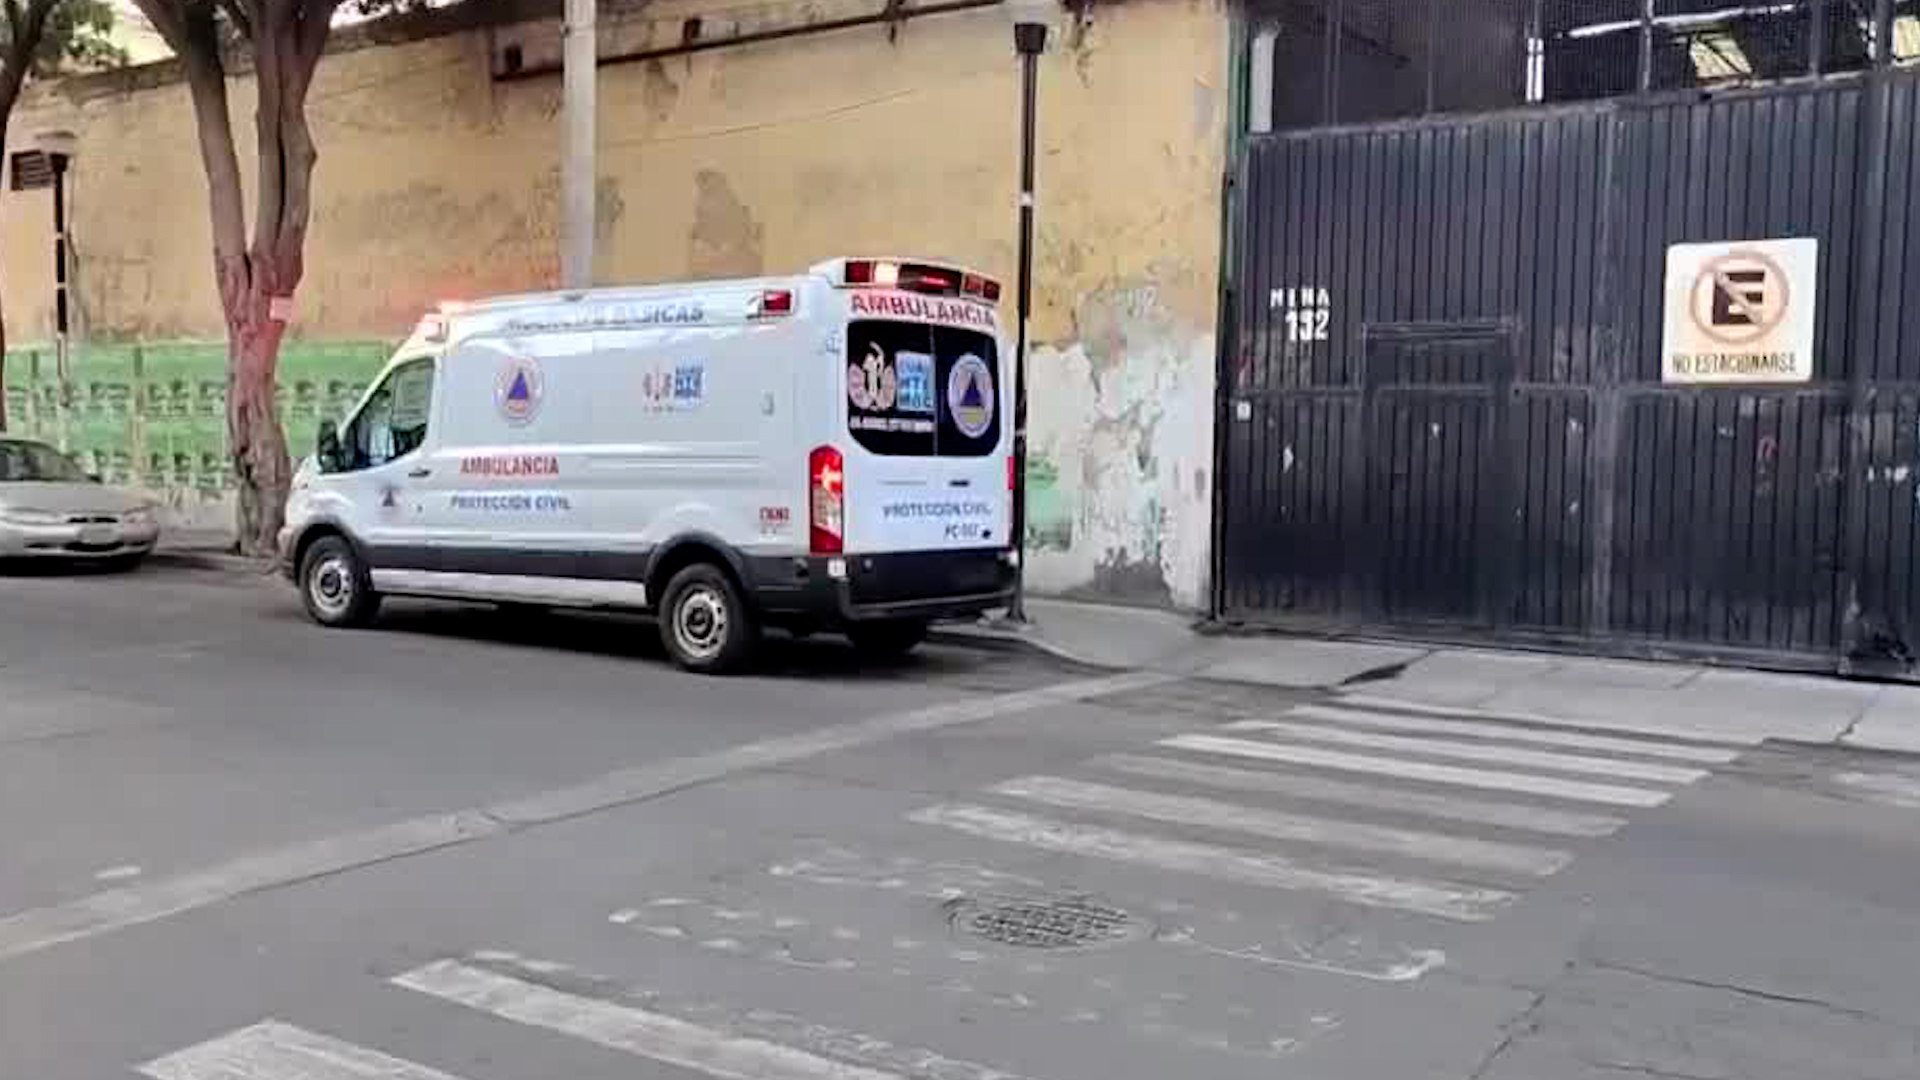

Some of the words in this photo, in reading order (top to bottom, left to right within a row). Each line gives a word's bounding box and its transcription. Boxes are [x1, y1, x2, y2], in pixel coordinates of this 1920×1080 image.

[1270, 287, 1330, 307] MINA
[851, 294, 994, 325] AMBULANCIA
[1285, 308, 1329, 341] 132
[1672, 354, 1693, 374] NO
[1696, 351, 1797, 374] ESTACIONARSE
[461, 456, 558, 475] AMBULANCIA
[535, 494, 571, 510] CIVIL
